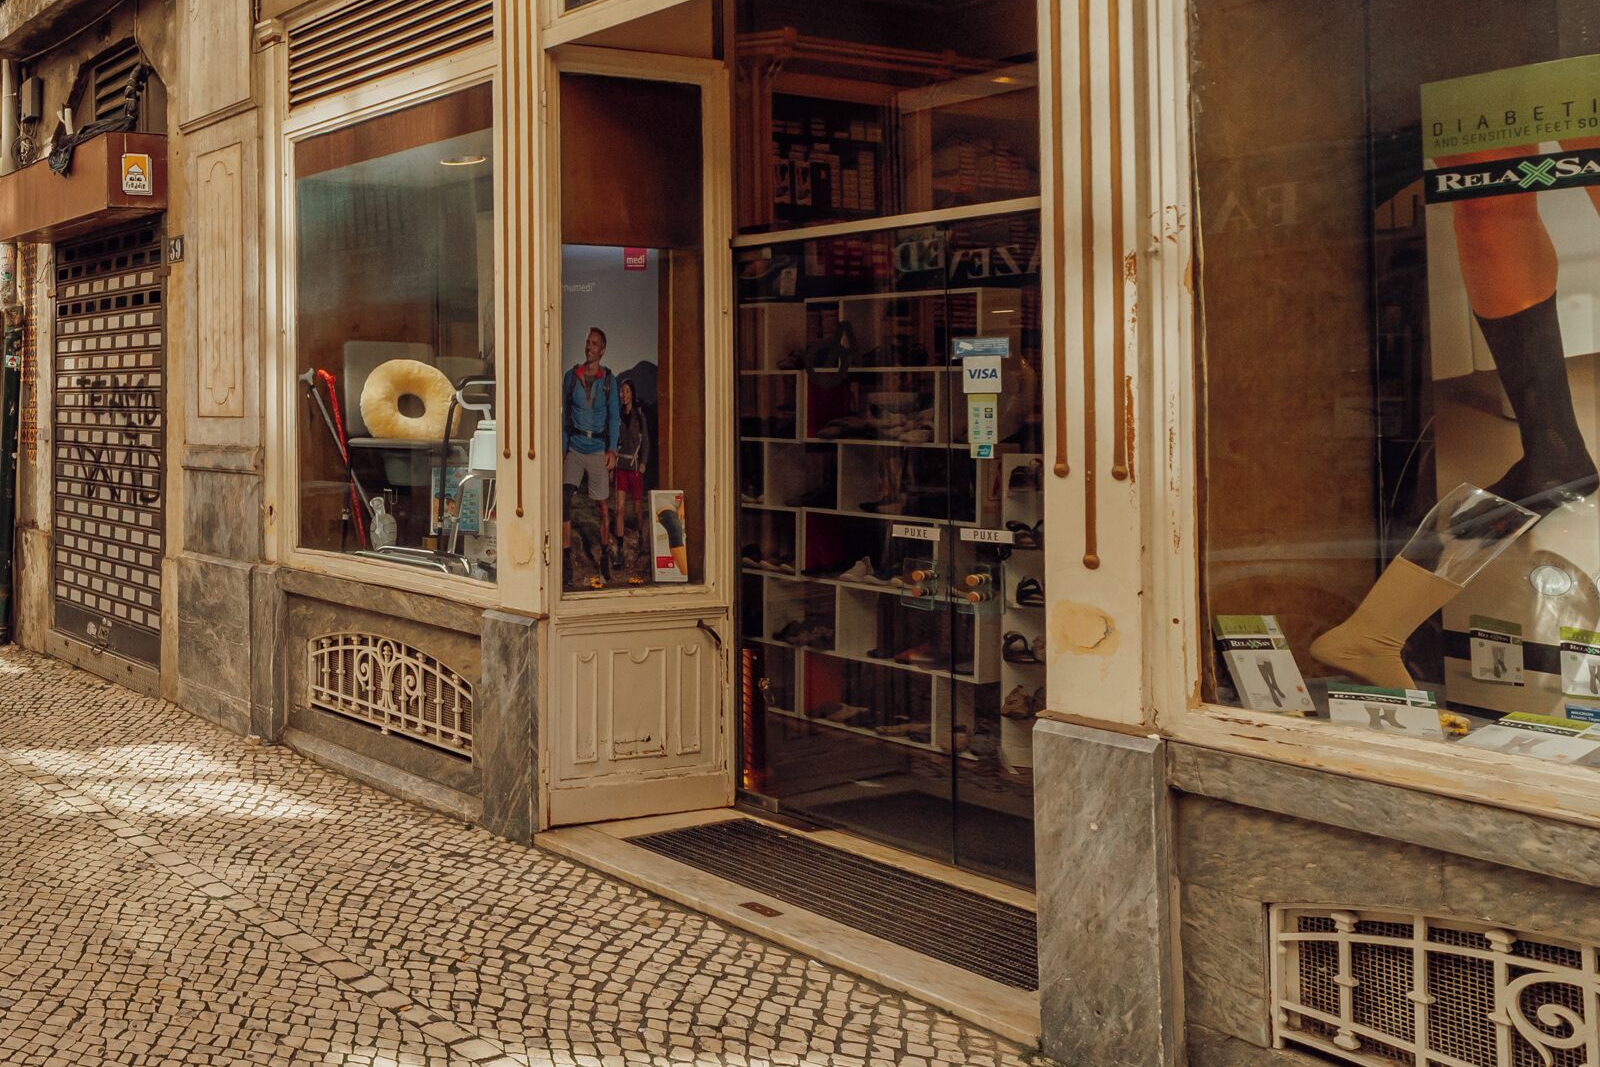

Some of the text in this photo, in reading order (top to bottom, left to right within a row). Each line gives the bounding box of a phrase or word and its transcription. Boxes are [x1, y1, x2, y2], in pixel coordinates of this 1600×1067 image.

[1434, 136, 1458, 149] AND
[1462, 126, 1531, 146] SENSITIVE
[1536, 120, 1574, 134] FEET
[626, 254, 645, 265] medi
[967, 368, 998, 380] VISA
[904, 526, 928, 539] PUXE
[973, 530, 1000, 542] PUXE
